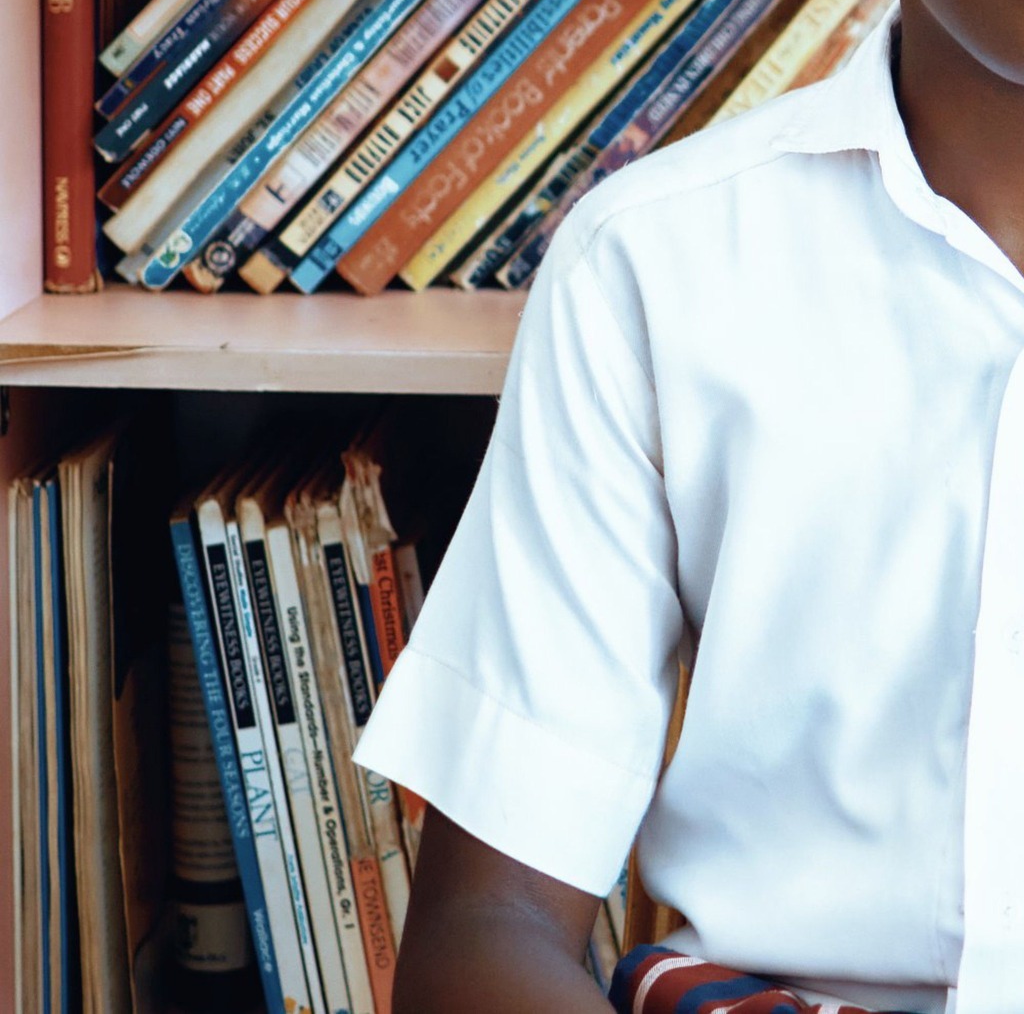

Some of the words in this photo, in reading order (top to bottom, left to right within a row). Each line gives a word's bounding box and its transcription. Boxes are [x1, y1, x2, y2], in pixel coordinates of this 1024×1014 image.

[150, 21, 190, 61] Tracy
[161, 37, 213, 90] MARRIAGE
[230, 13, 282, 65] SUCCESS
[184, 86, 214, 117] ONE
[205, 62, 238, 96] PART
[460, 76, 489, 105] of
[476, 77, 543, 148] Book
[404, 97, 471, 167] Prayer
[456, 134, 494, 172] of
[398, 159, 468, 233] Facts
[176, 540, 216, 667] DISCOVERING
[211, 561, 240, 657] EYEWITNESS
[228, 657, 250, 709] BOOKS
[249, 558, 279, 653] EYEWITNESS
[267, 653, 289, 706] BOOKS
[328, 555, 359, 659] EYEWITNESS
[347, 658, 369, 714] BOOKS
[203, 669, 223, 704] THE
[283, 605, 303, 644] Using
[293, 645, 308, 669] the
[322, 804, 333, 815] &
[210, 706, 234, 758] FOUR
[220, 758, 250, 840] SEASONS
[239, 749, 276, 841] PLANT
[360, 876, 390, 971] TOWNSEND
